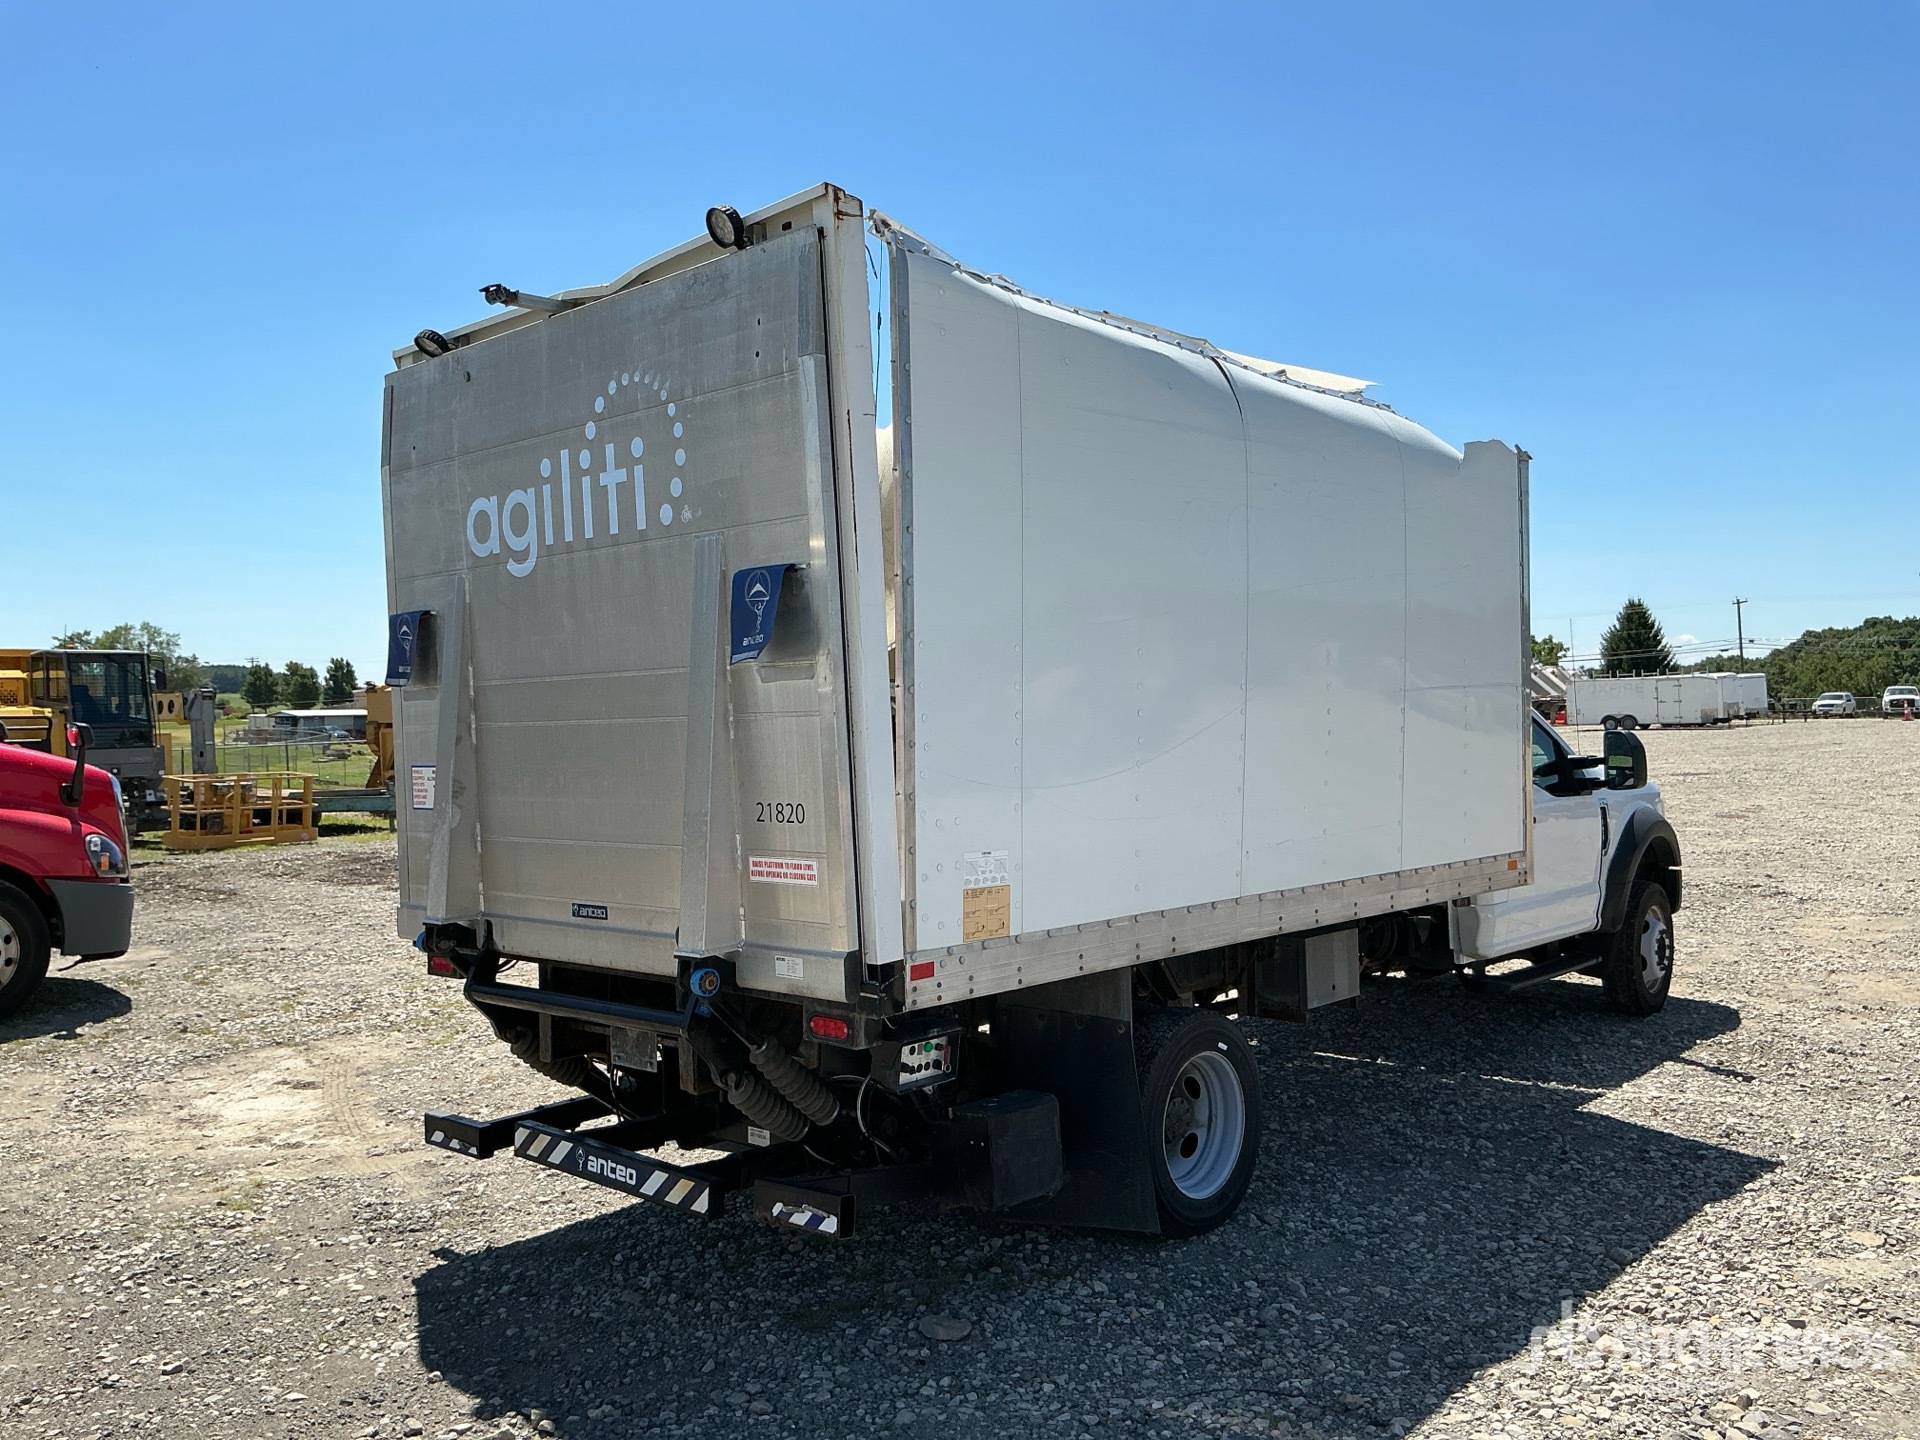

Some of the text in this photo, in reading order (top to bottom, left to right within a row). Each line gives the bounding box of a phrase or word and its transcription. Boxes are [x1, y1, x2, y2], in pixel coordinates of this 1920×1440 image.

[466, 436, 647, 578] agiliti
[755, 801, 806, 824] 21820
[751, 869, 765, 877] BEFORE
[764, 861, 784, 869] PLATFORM
[784, 862, 790, 870] TO
[790, 862, 803, 871] FLOOR
[579, 907, 606, 918] anteo
[587, 1155, 637, 1186] anteo
